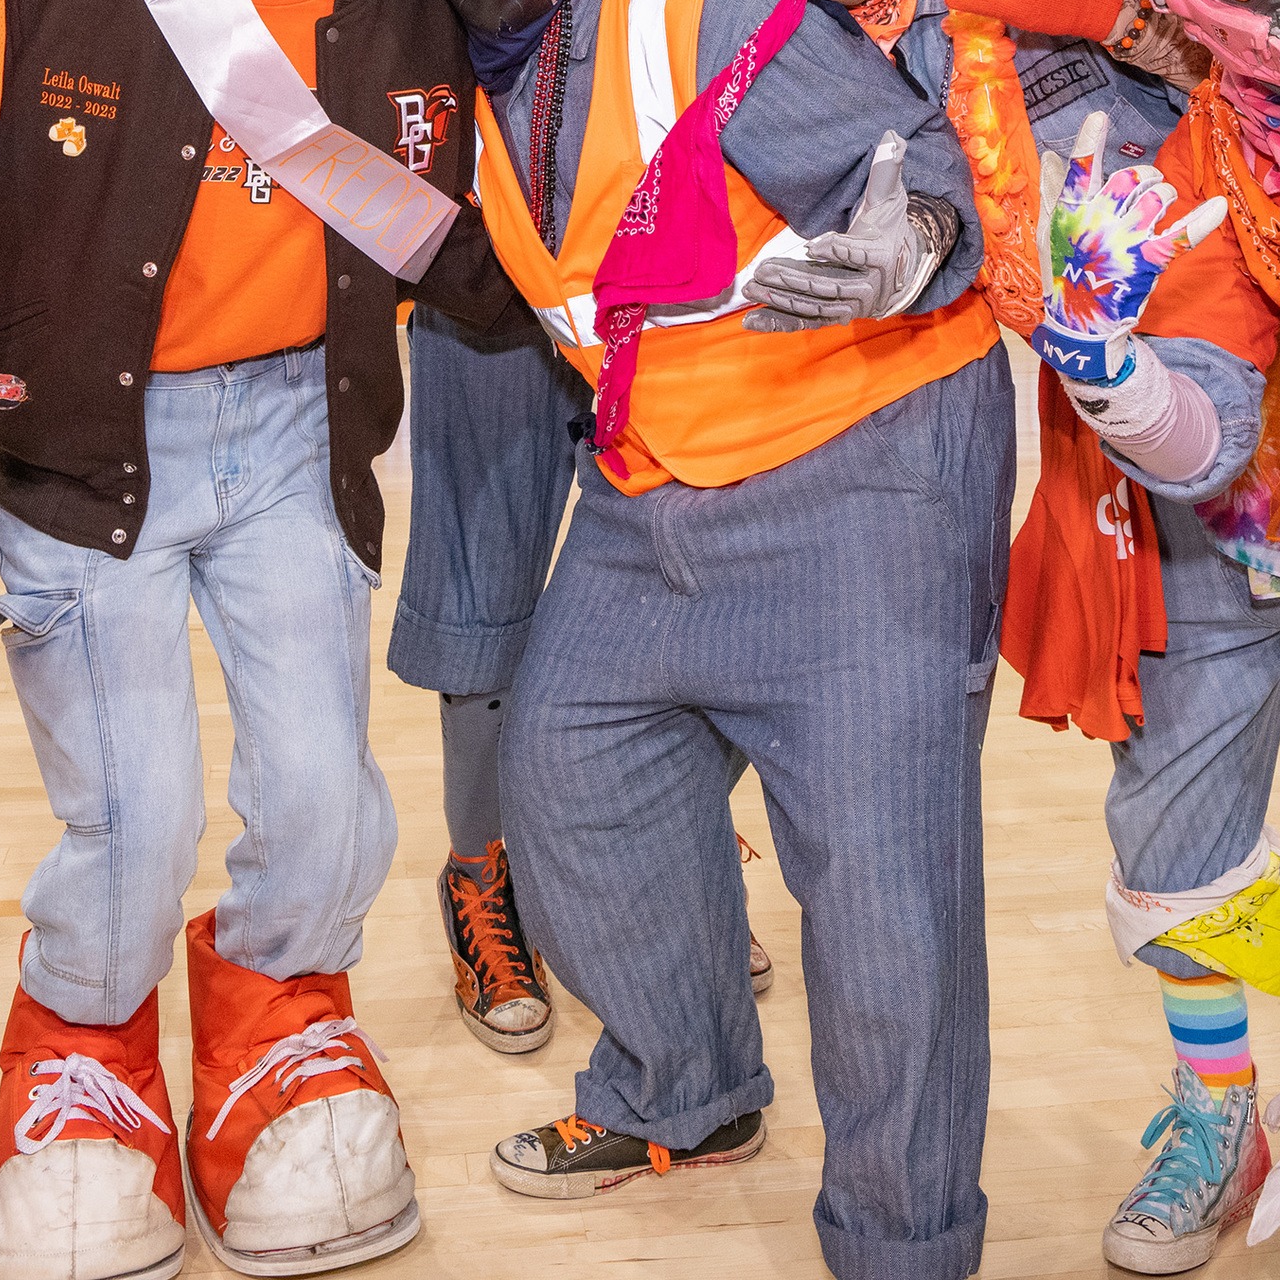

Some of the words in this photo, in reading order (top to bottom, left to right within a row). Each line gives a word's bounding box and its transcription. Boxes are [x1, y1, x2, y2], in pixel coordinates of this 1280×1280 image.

[42, 67, 75, 90] Leila
[78, 75, 121, 100] Oswalt
[40, 91, 73, 109] 2022
[84, 101, 117, 119] 2023
